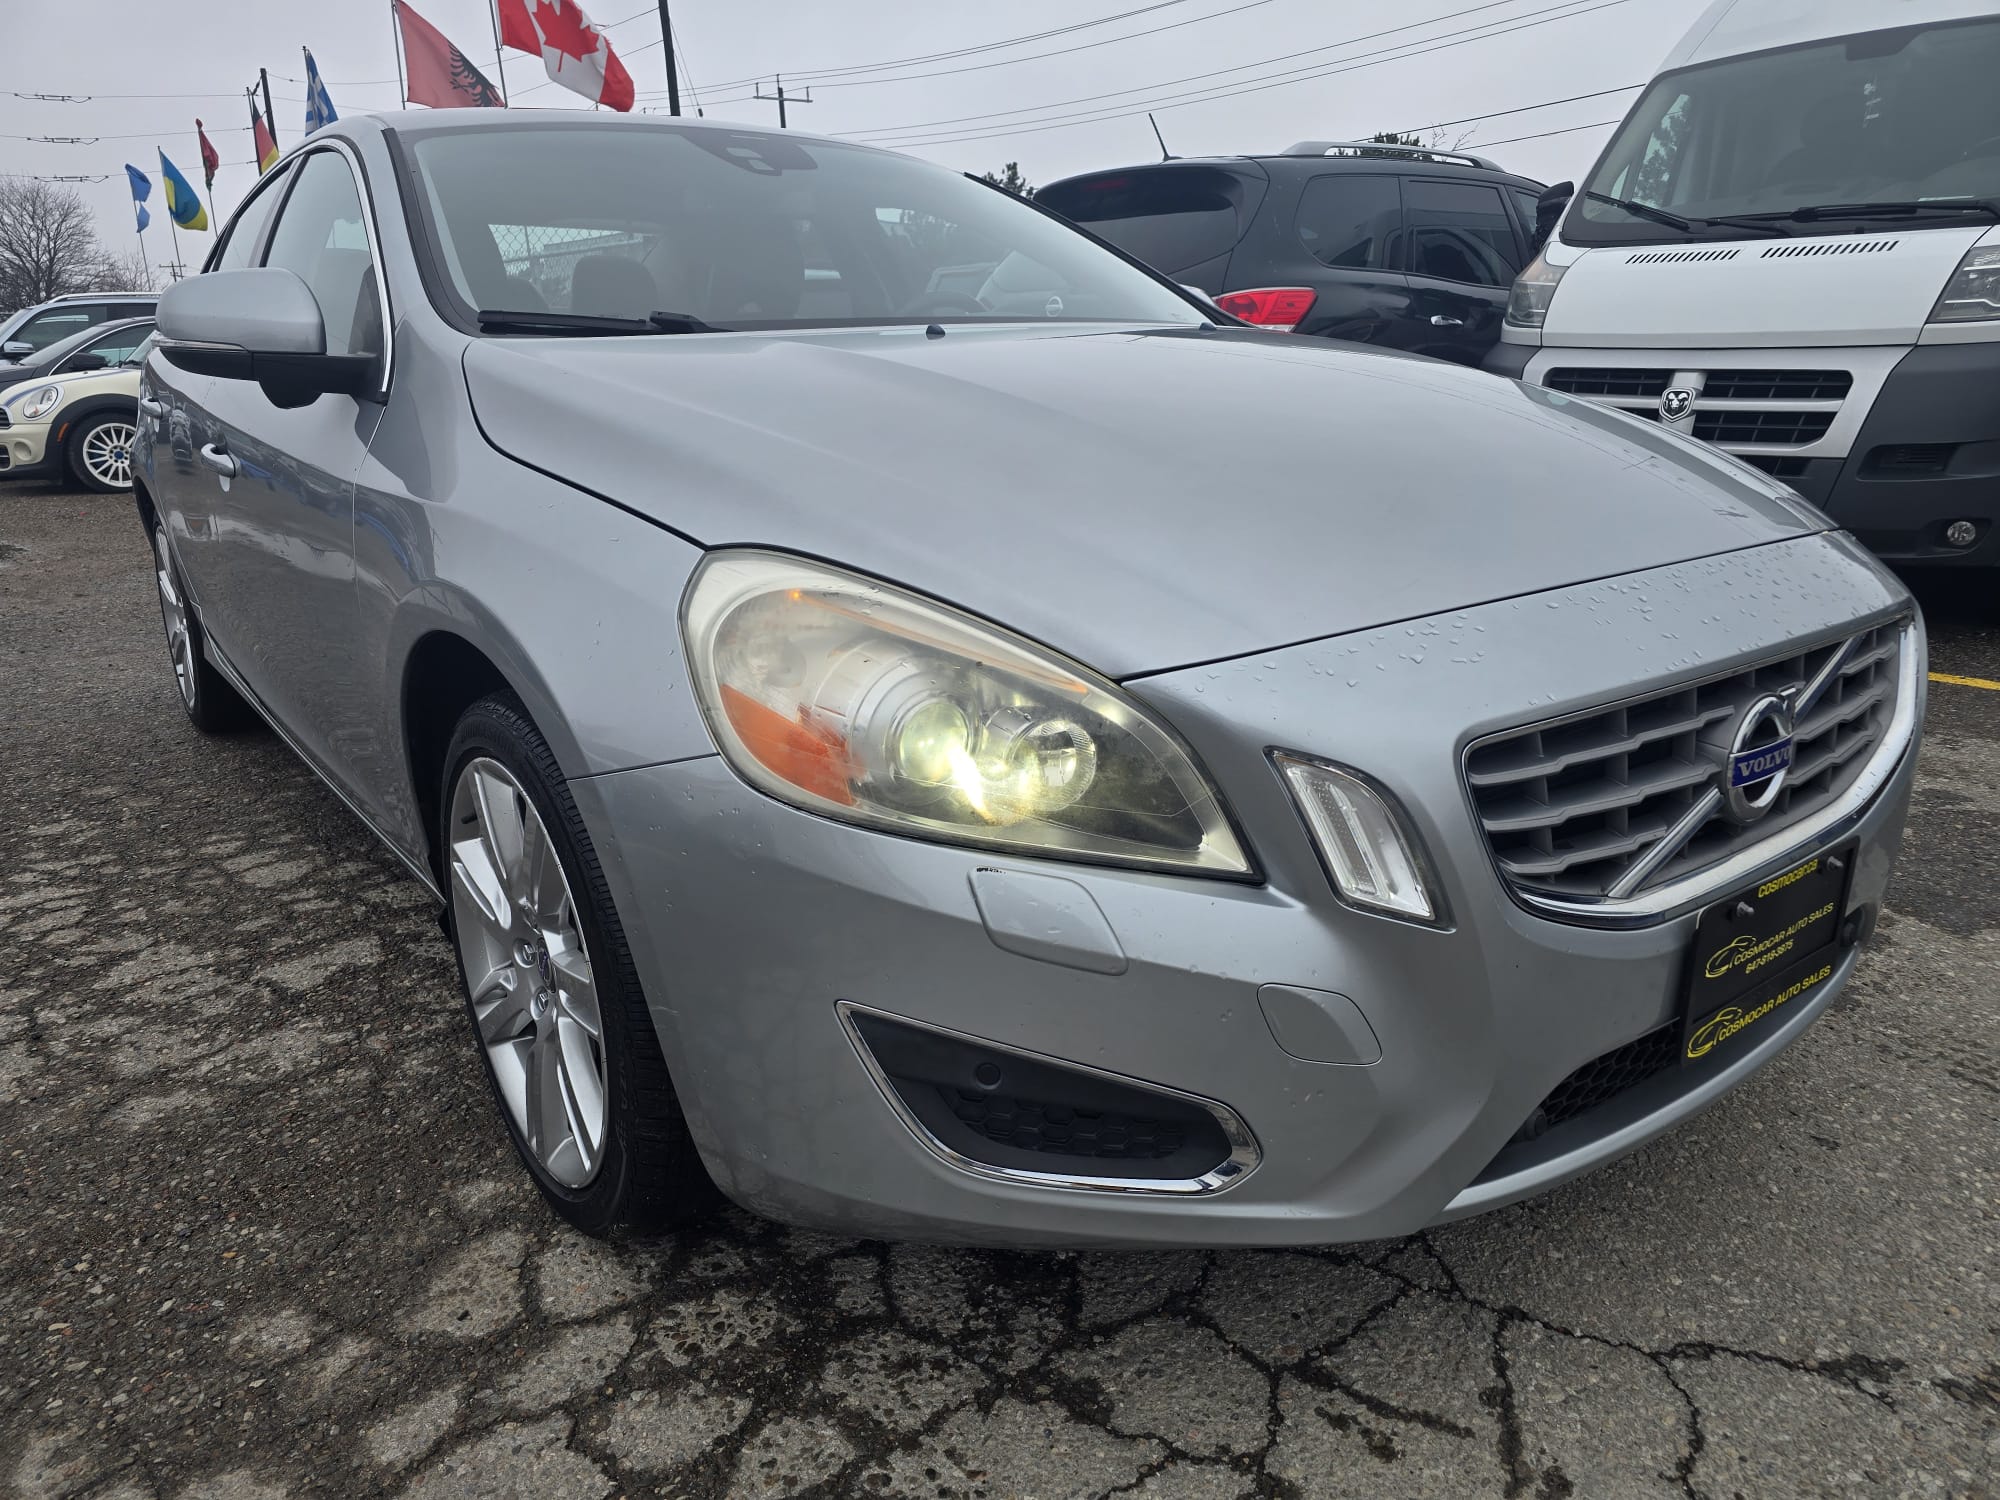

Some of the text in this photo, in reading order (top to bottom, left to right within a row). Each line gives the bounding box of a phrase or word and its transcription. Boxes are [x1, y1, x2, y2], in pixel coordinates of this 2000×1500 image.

[1738, 746, 1791, 776] VOLVO
[1734, 902, 1834, 965] COSMOCAR AUTO SALES
[1718, 965, 1831, 1041] COSMOCAR AUTO SALES
